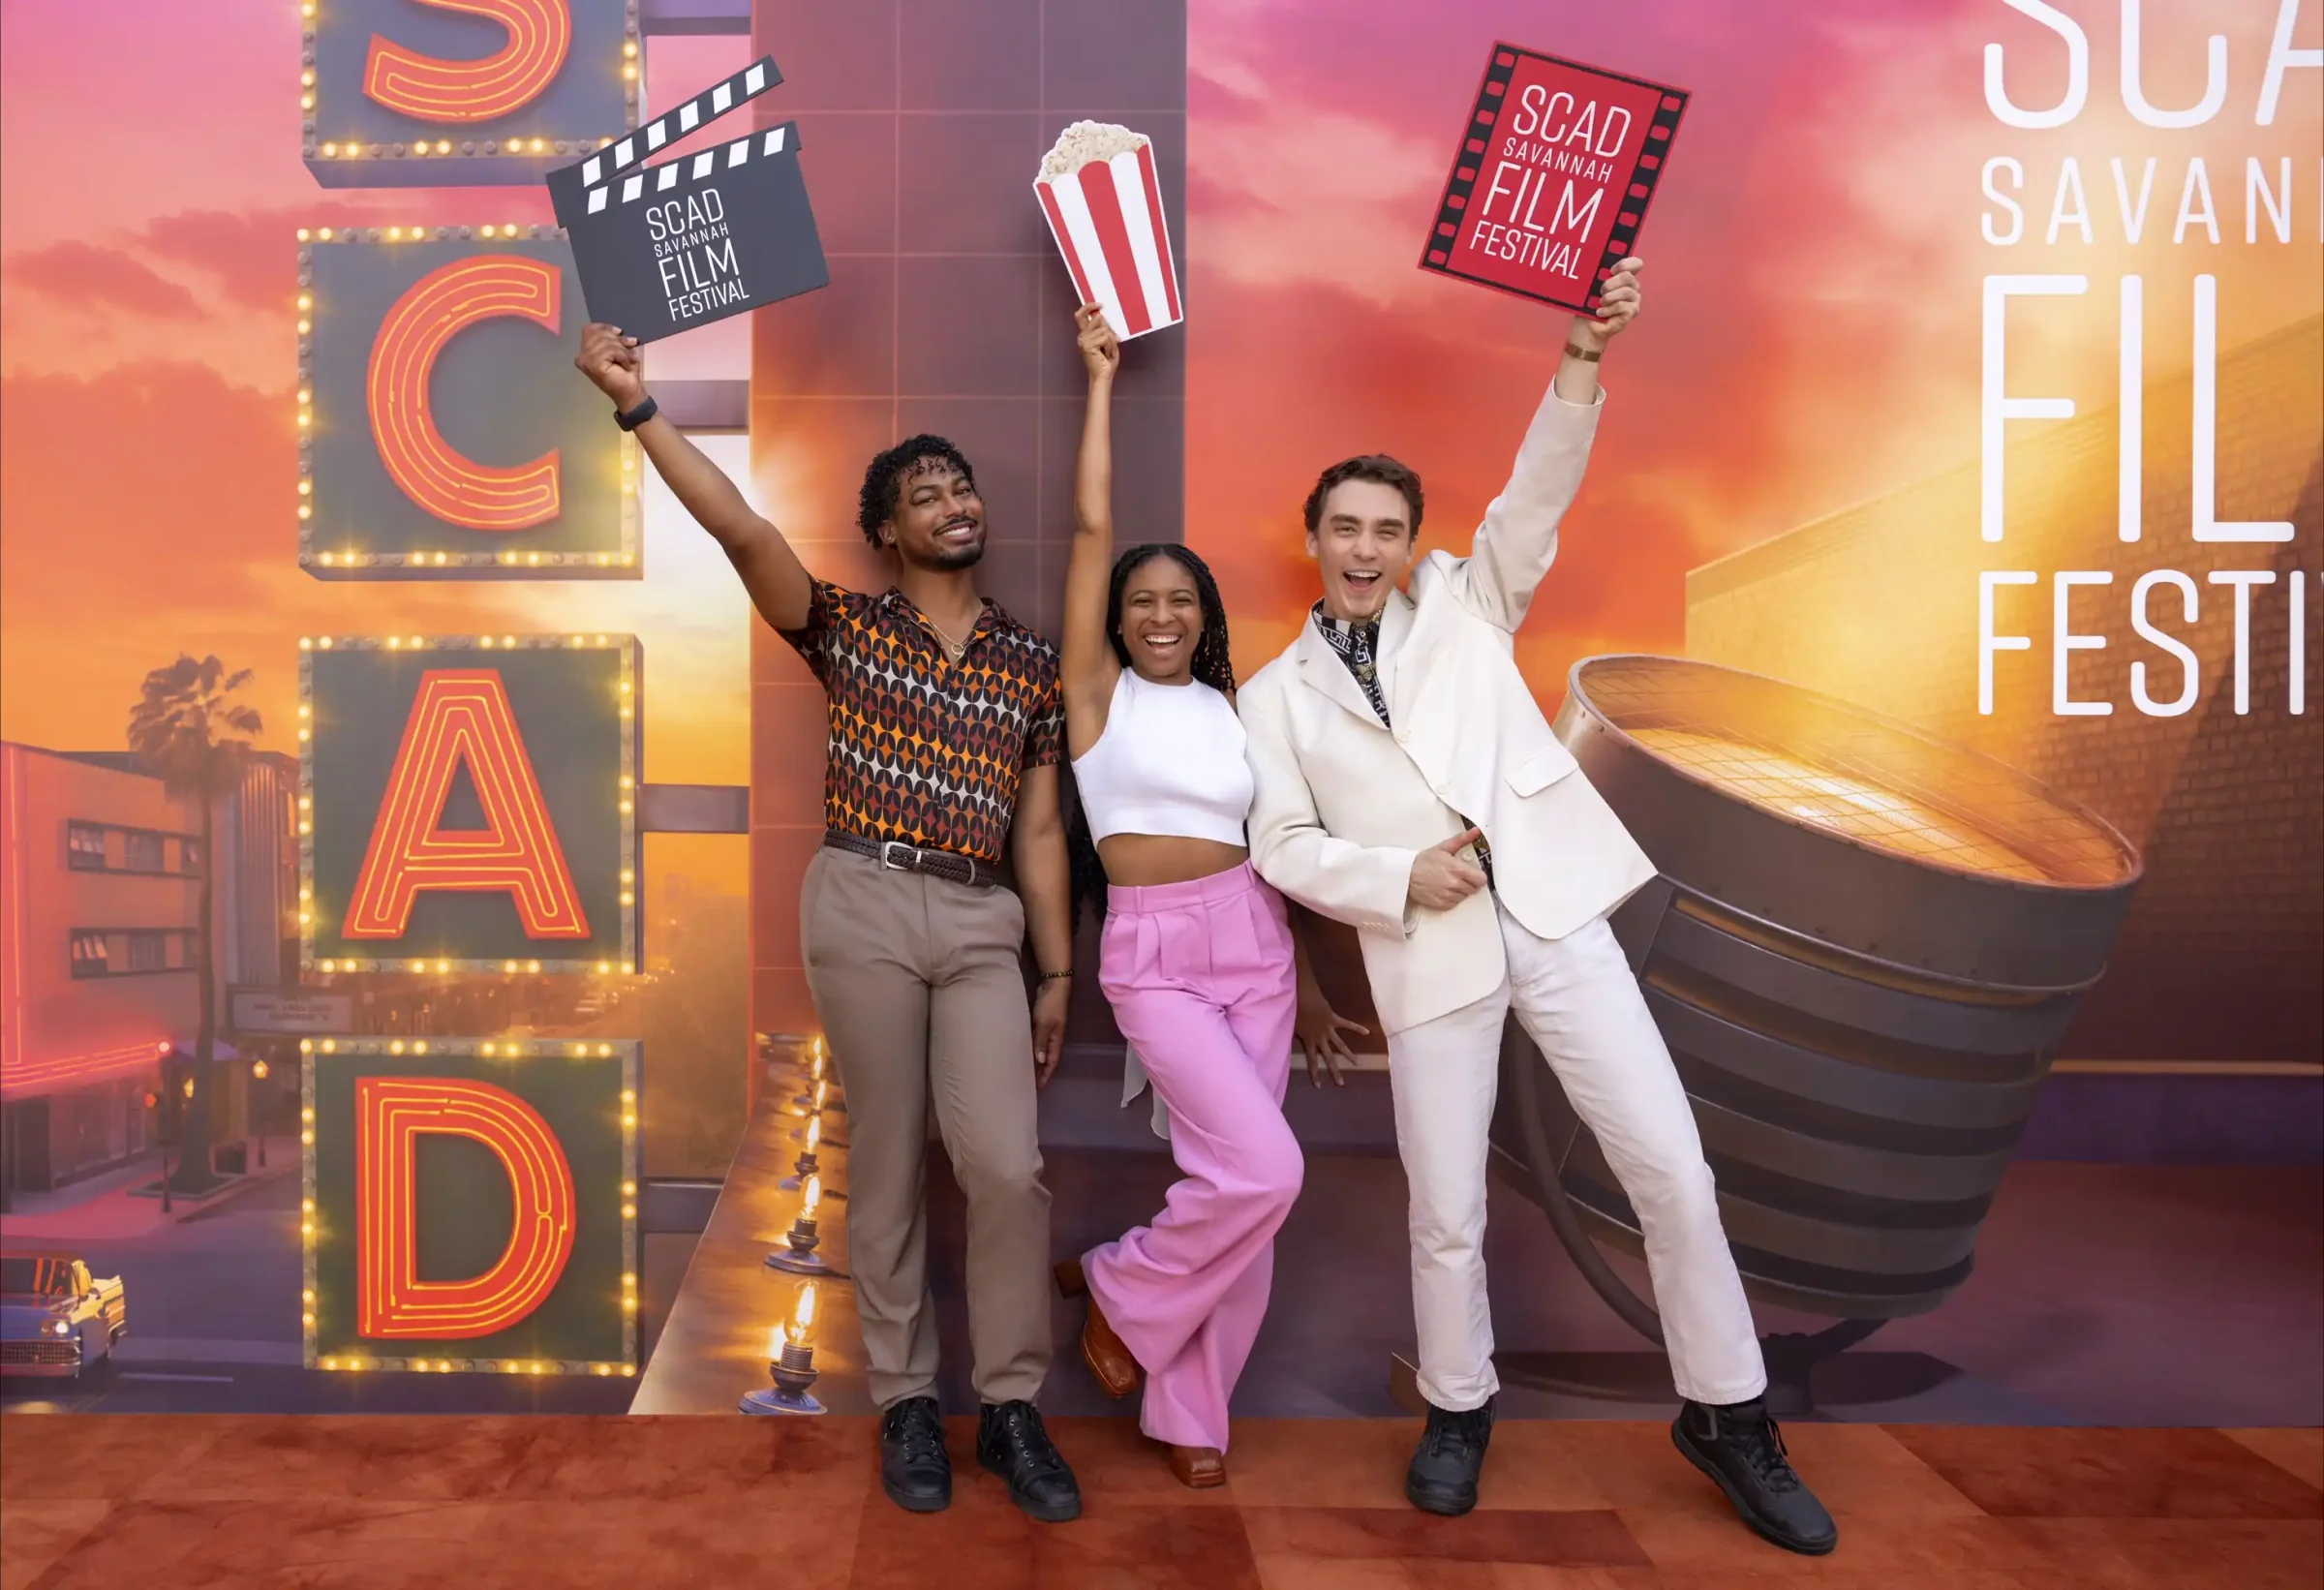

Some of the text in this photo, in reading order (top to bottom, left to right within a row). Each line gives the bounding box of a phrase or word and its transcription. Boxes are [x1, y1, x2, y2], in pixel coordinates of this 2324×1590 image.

[1513, 84, 1632, 158] SCAD
[1503, 137, 1613, 183] SAVANNAH
[646, 188, 724, 241] SCAD
[1482, 161, 1605, 243] FILM
[1981, 156, 2323, 246] SAVAN
[654, 222, 729, 258] SAVANNAH
[657, 237, 740, 298] FILM
[1470, 220, 1582, 280] FESTIVAL
[668, 278, 750, 321] FESTIVAL
[1978, 569, 2323, 717] FESTI
